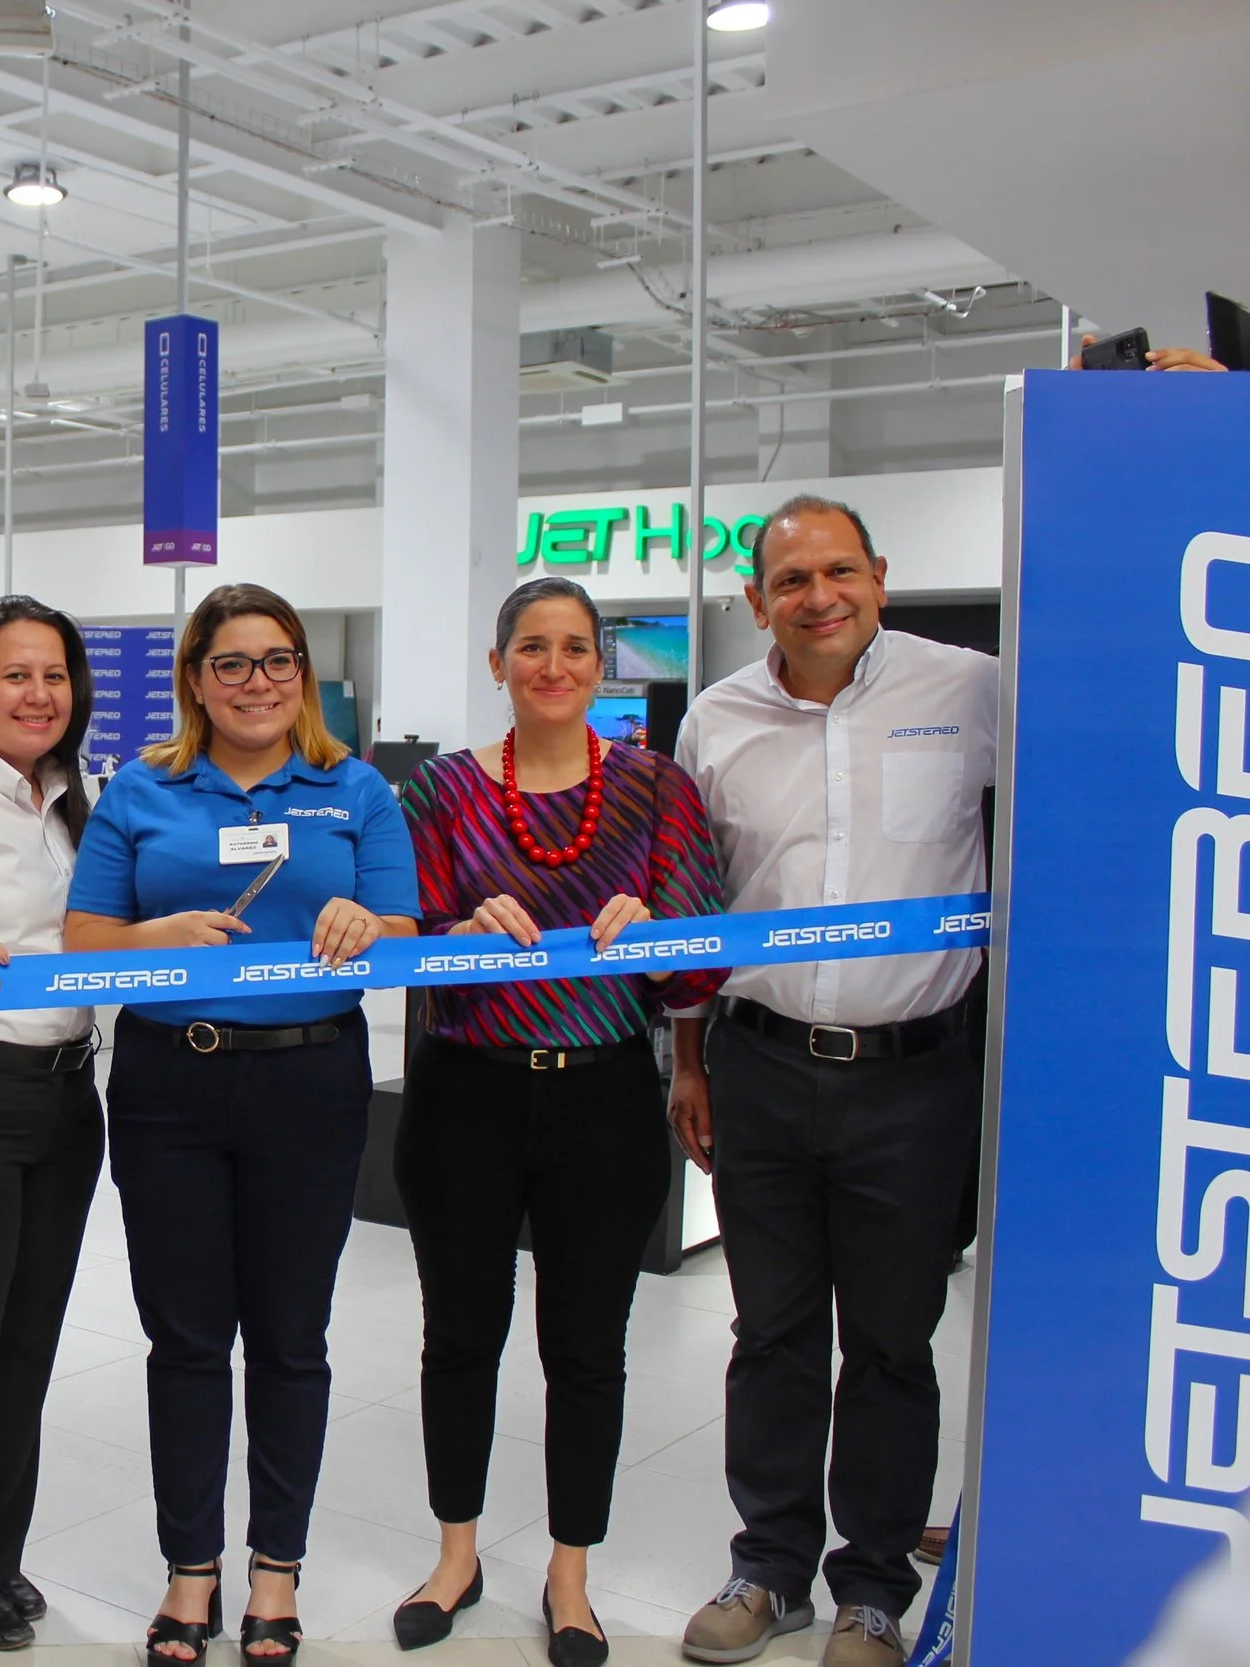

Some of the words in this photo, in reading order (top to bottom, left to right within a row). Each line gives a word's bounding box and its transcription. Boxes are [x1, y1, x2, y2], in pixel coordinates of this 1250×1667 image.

[160, 358, 169, 432] CELULARES
[198, 359, 207, 432] CELULARES
[518, 507, 629, 566] JET
[146, 631, 174, 639] JETST
[146, 648, 174, 656] JETST
[146, 669, 173, 677] JETST
[145, 690, 174, 699] JETST
[145, 711, 174, 719] JETST
[887, 726, 960, 738] JETSTEREO
[284, 807, 349, 820] JETSTEREO
[46, 968, 187, 992] JETSTEREO
[414, 951, 548, 973] JETSTEREO
[762, 921, 891, 947] JETSTEREO
